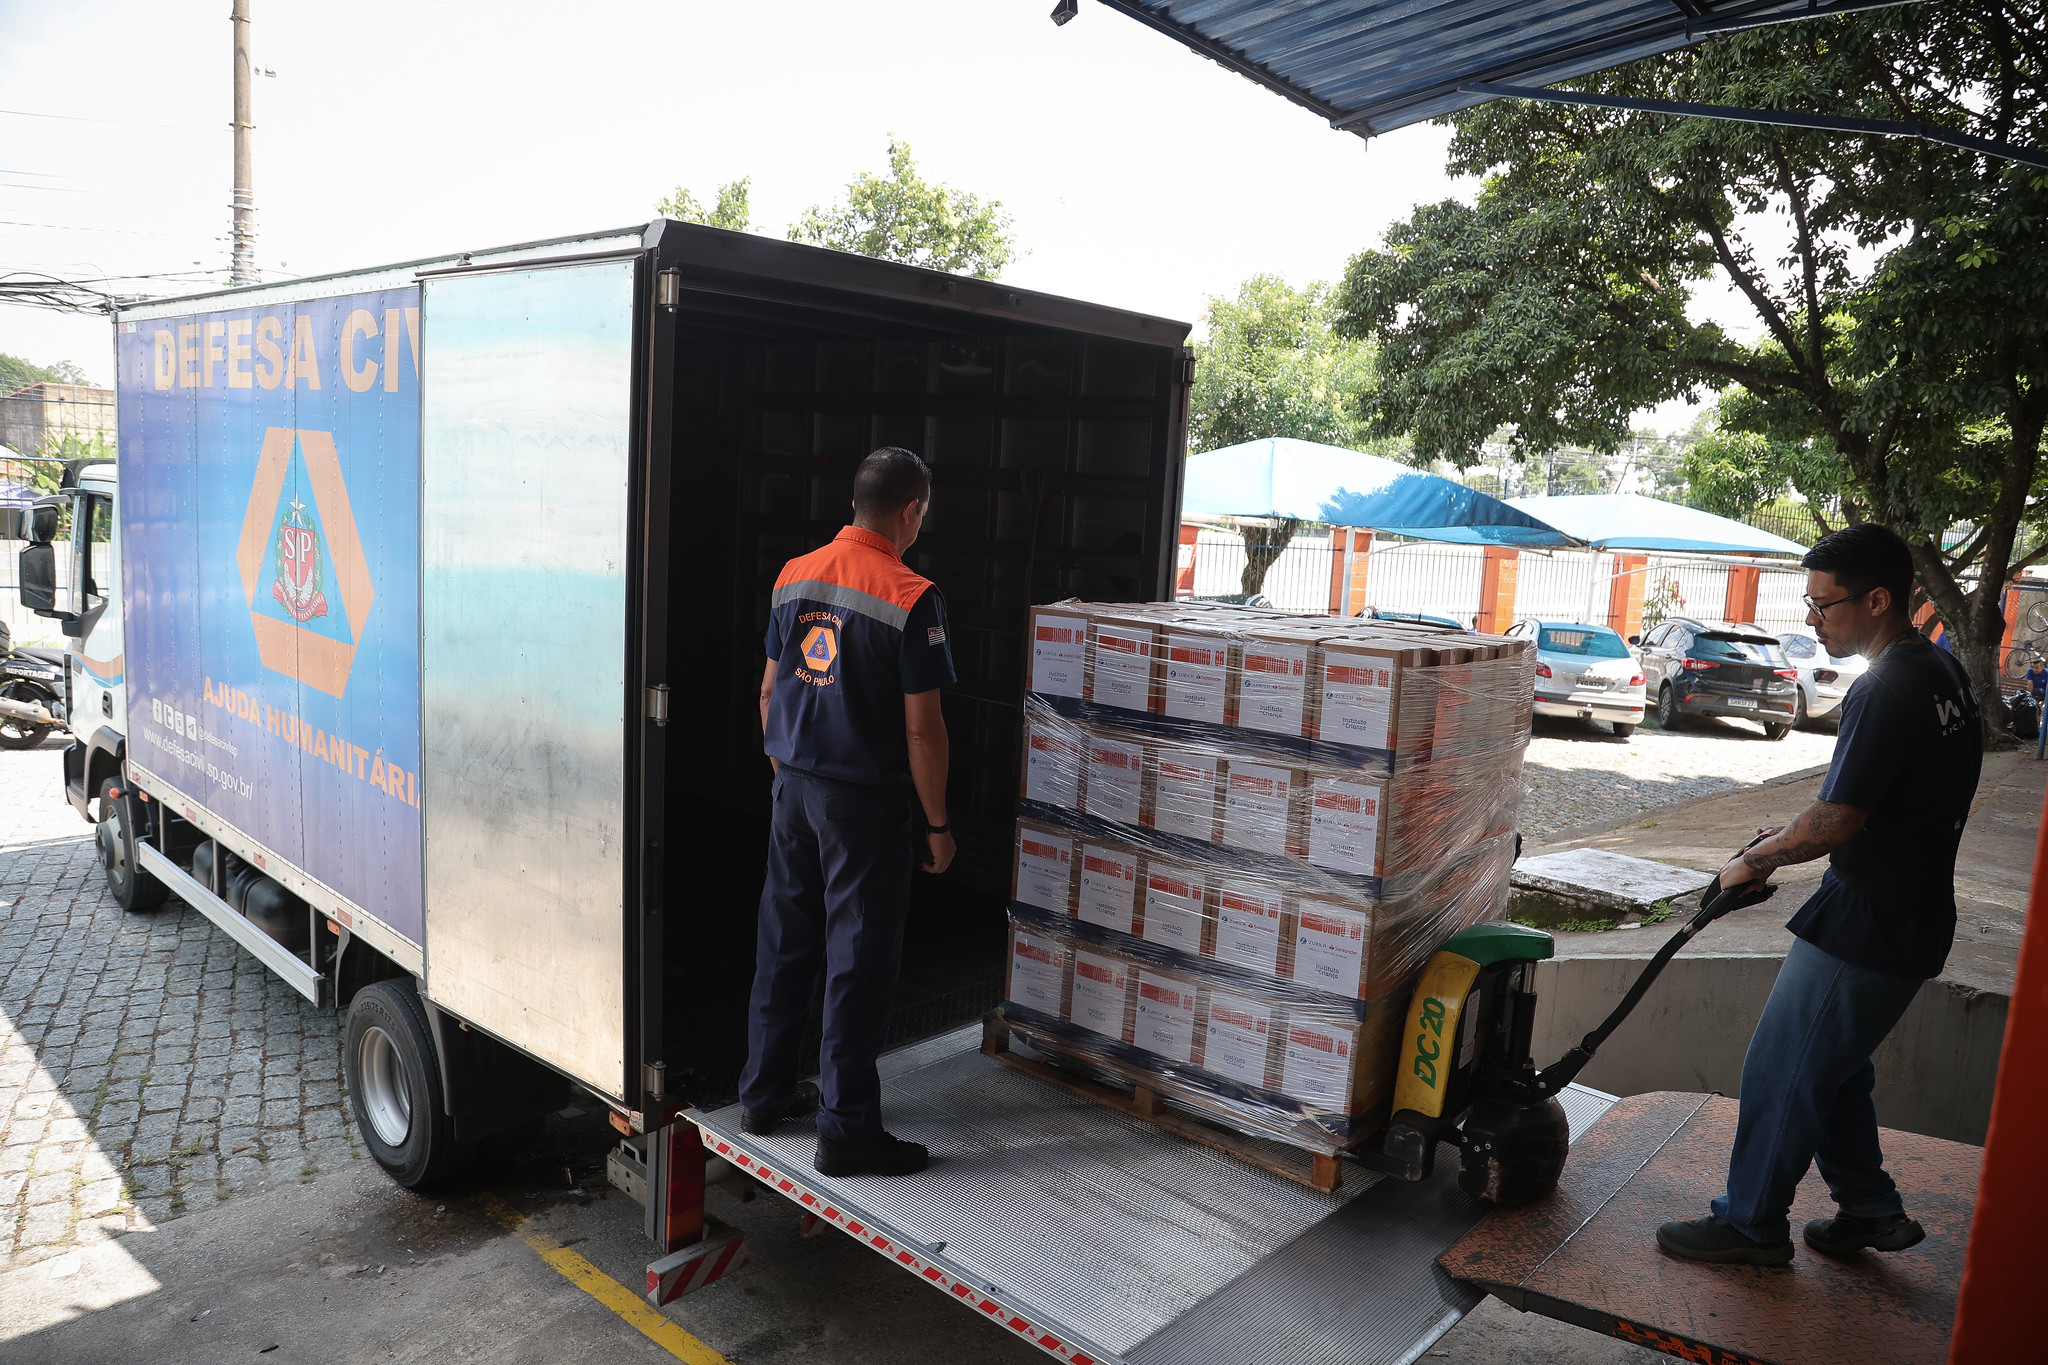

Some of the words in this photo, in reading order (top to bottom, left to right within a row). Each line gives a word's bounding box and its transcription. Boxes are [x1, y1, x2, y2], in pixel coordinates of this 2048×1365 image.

[154, 315, 321, 390] DEFESA
[799, 612, 831, 623] DEFESA
[795, 668, 812, 683] SÃO
[813, 675, 834, 686] PAULO
[1343, 717, 1367, 725] Instituto
[204, 676, 262, 727] AJUDA
[267, 704, 420, 809] HUMANITÁRI
[143, 727, 253, 800] www.defesacivil.sp.gov.br/
[1254, 925, 1275, 933] Santander
[1335, 946, 1357, 955] Santander
[1316, 964, 1339, 973] Instituto
